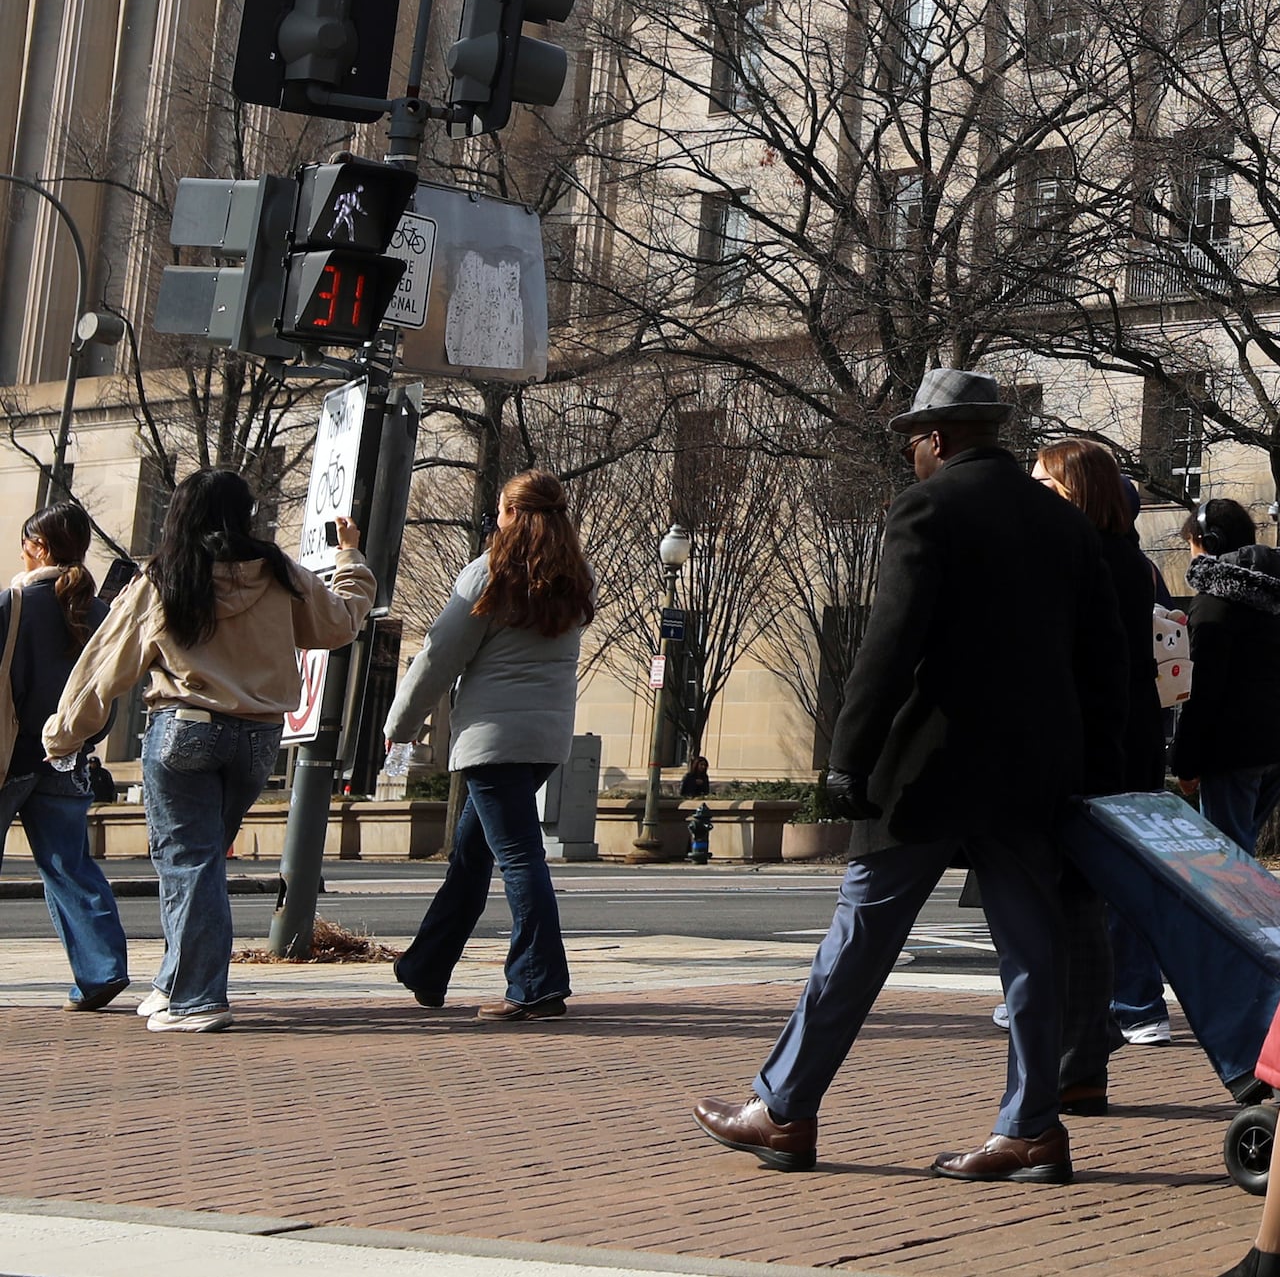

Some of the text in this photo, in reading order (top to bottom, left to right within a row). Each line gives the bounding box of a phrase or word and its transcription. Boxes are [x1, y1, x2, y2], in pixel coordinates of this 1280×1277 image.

[313, 265, 365, 328] 31
[390, 294, 417, 314] GNAL
[1117, 812, 1204, 839] Life
[1148, 836, 1231, 853] CREATED?
